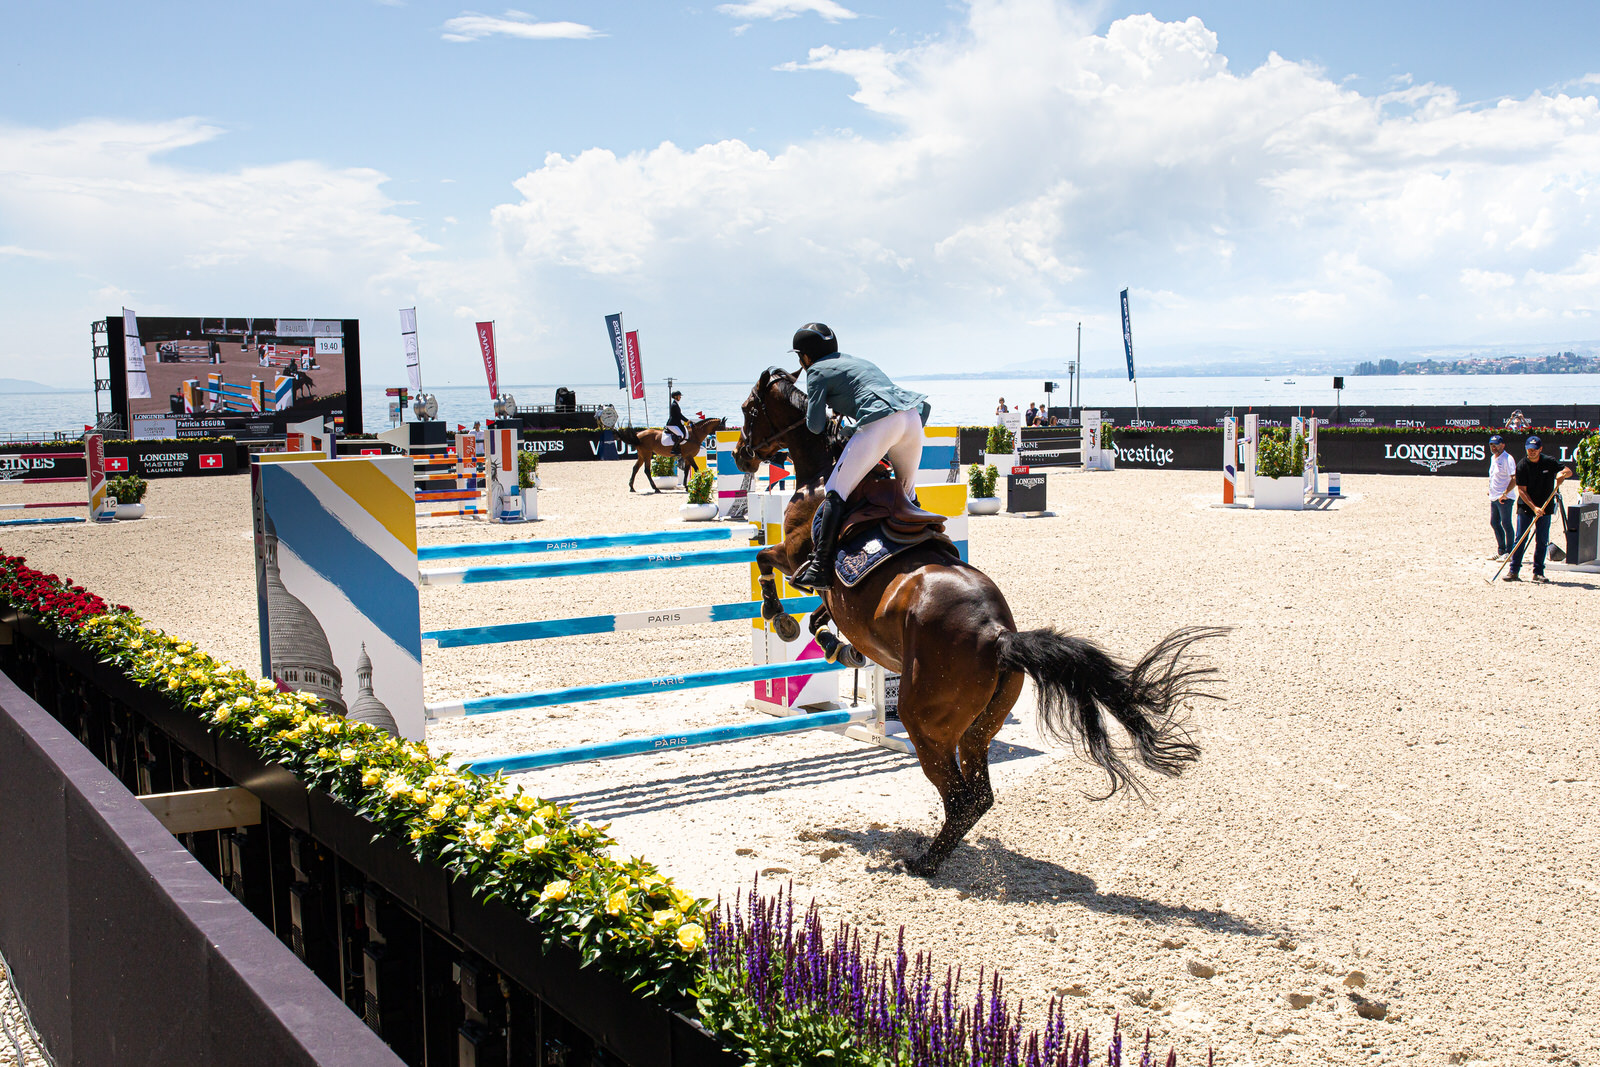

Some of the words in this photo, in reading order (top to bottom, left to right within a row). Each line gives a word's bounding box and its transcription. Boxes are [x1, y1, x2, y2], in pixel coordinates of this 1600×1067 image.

[320, 342, 338, 350] 19.40
[1556, 420, 1590, 428] EEM.TV
[524, 440, 564, 452] GINES
[1384, 444, 1486, 460] LONGINES
[140, 453, 188, 462] LONGINES
[104, 500, 116, 508] 12
[514, 498, 518, 506] 1
[546, 542, 578, 550] PARIS
[648, 554, 682, 562] PARIS
[648, 614, 681, 624] PARIS
[652, 677, 685, 687] PARIS
[654, 736, 688, 748] PARIS
[872, 734, 881, 744] P12
